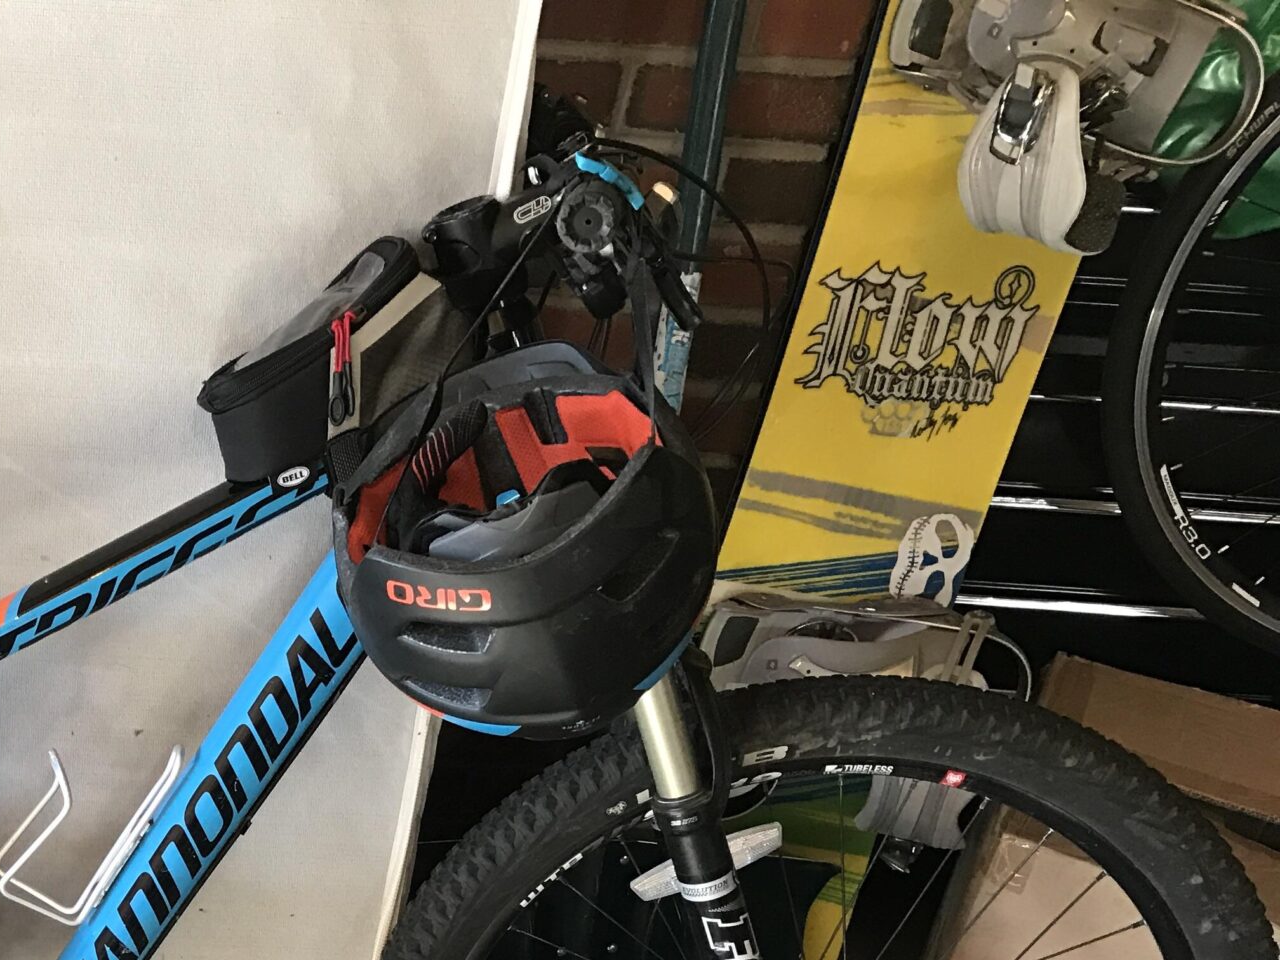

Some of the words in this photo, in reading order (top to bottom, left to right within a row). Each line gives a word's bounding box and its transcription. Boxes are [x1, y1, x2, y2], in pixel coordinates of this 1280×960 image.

[282, 470, 305, 484] BELL
[1173, 514, 1212, 560] R3.0
[386, 579, 492, 612] GIRO
[844, 764, 894, 775] TUBELESS
